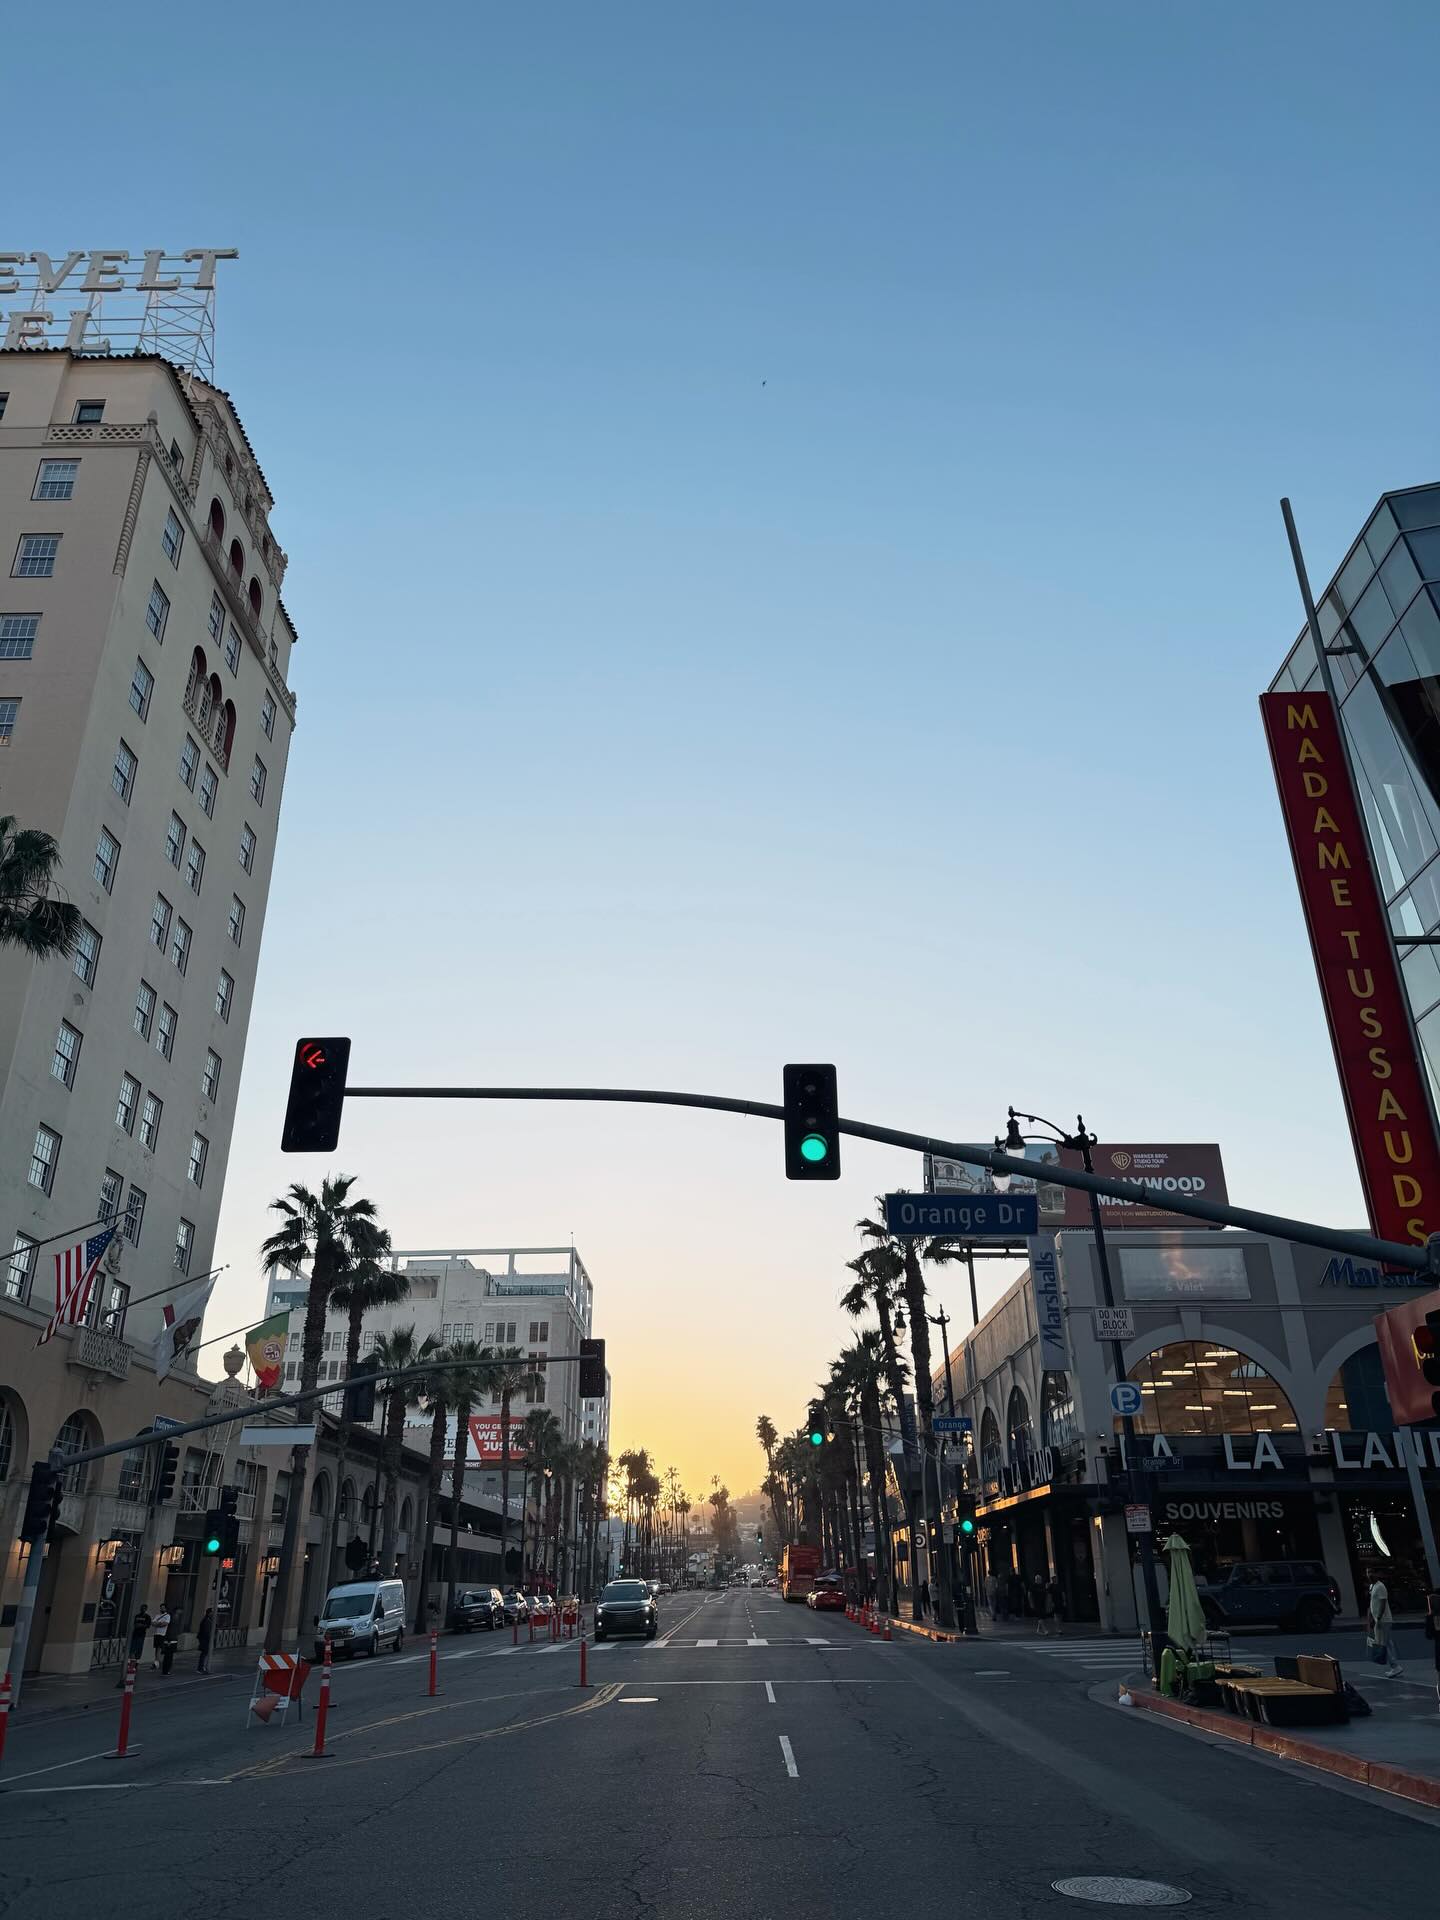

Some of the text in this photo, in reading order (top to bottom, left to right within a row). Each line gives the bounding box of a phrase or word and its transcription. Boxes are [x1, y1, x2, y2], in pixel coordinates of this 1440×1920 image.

[0, 310, 111, 354] EL
[1287, 704, 1431, 1248] MADAME TUSSAUDS
[900, 1202, 1025, 1230] Orange Dr
[1035, 1251, 1065, 1350] Marshalls
[1098, 1309, 1128, 1319] DO NOT
[1102, 1319, 1128, 1329] BLOCK
[1116, 1387, 1136, 1411] P
[477, 1431, 497, 1440] WE
[1223, 1432, 1285, 1470] LA
[1011, 1459, 1023, 1493] LA
[1027, 1447, 1053, 1488] LAND
[1166, 1502, 1285, 1521] SOUVENIRS
